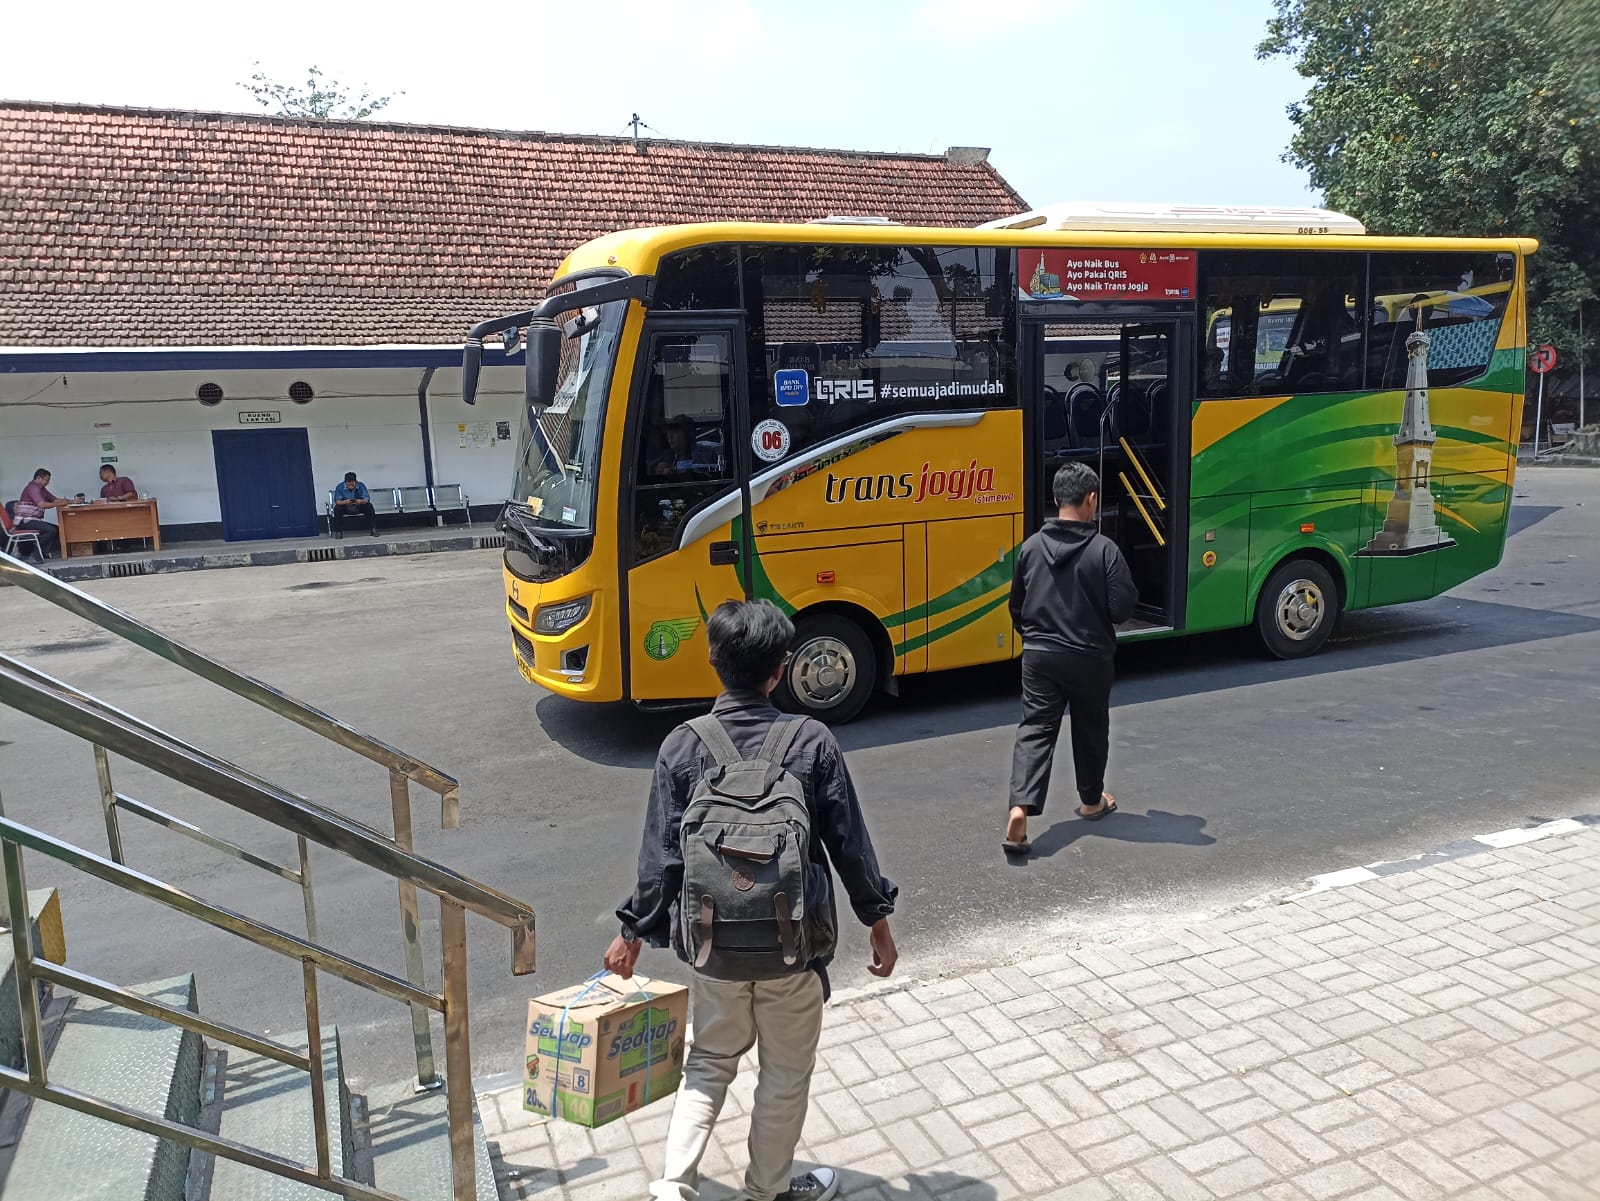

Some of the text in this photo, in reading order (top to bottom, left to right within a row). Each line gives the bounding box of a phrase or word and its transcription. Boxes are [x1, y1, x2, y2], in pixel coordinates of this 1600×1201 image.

[1067, 259, 1120, 269] Ayo Naik Bus
[1067, 270, 1128, 280] Ayo Pakai QRIS
[1067, 282, 1149, 292] Ayo Naik Trans Jogja
[816, 379, 1004, 404] QRIS #semuajadimudah
[762, 431, 782, 450] 06
[825, 472, 914, 504] trans
[913, 458, 995, 503] jogja
[577, 1075, 586, 1088] 8
